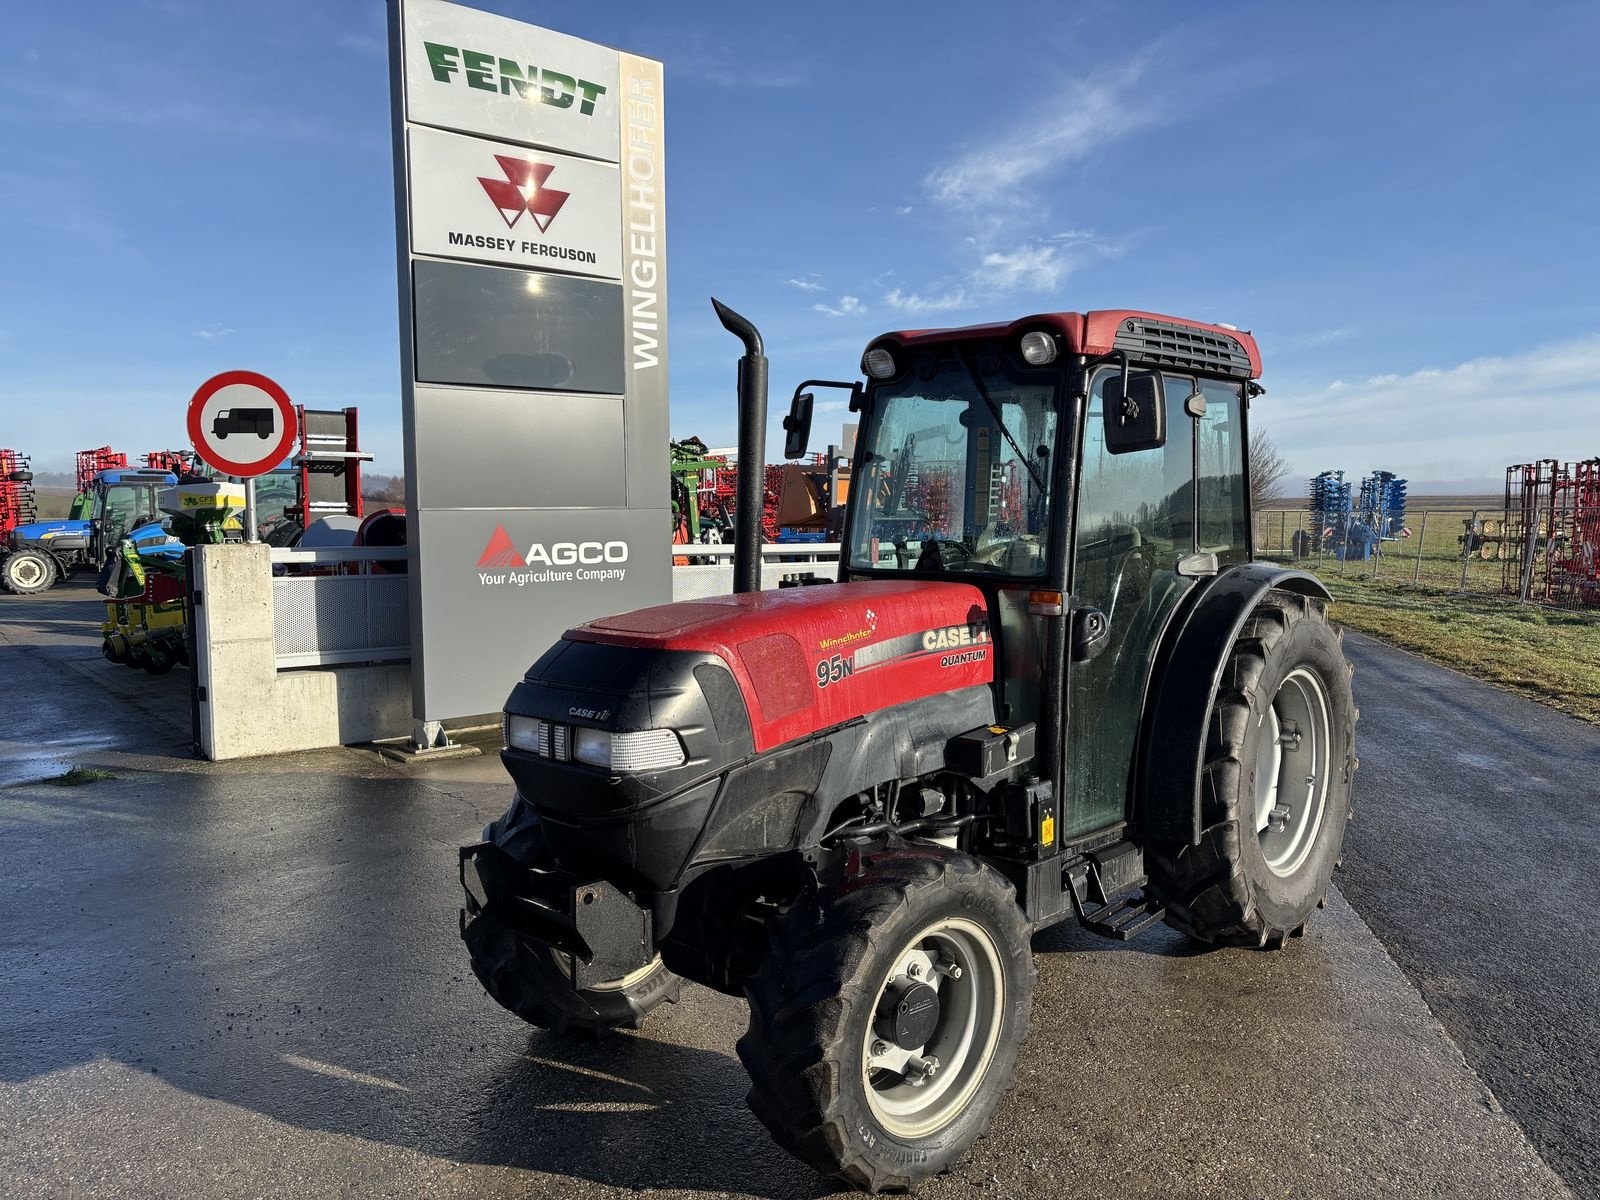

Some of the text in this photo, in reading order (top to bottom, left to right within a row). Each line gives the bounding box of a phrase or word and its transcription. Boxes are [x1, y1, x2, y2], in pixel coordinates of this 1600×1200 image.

[423, 41, 607, 116] FENDT
[628, 75, 660, 370] WINGELHOFER
[448, 231, 596, 264] MASSEY FERGUSON
[198, 495, 215, 503] CFS
[525, 541, 628, 566] AGCO
[478, 567, 626, 587] Your Agriculture Company
[922, 625, 971, 650] CASE
[816, 653, 854, 689] 95N
[940, 649, 986, 668] QUANTUM
[568, 706, 597, 719] CASE
[636, 967, 670, 999] itas
